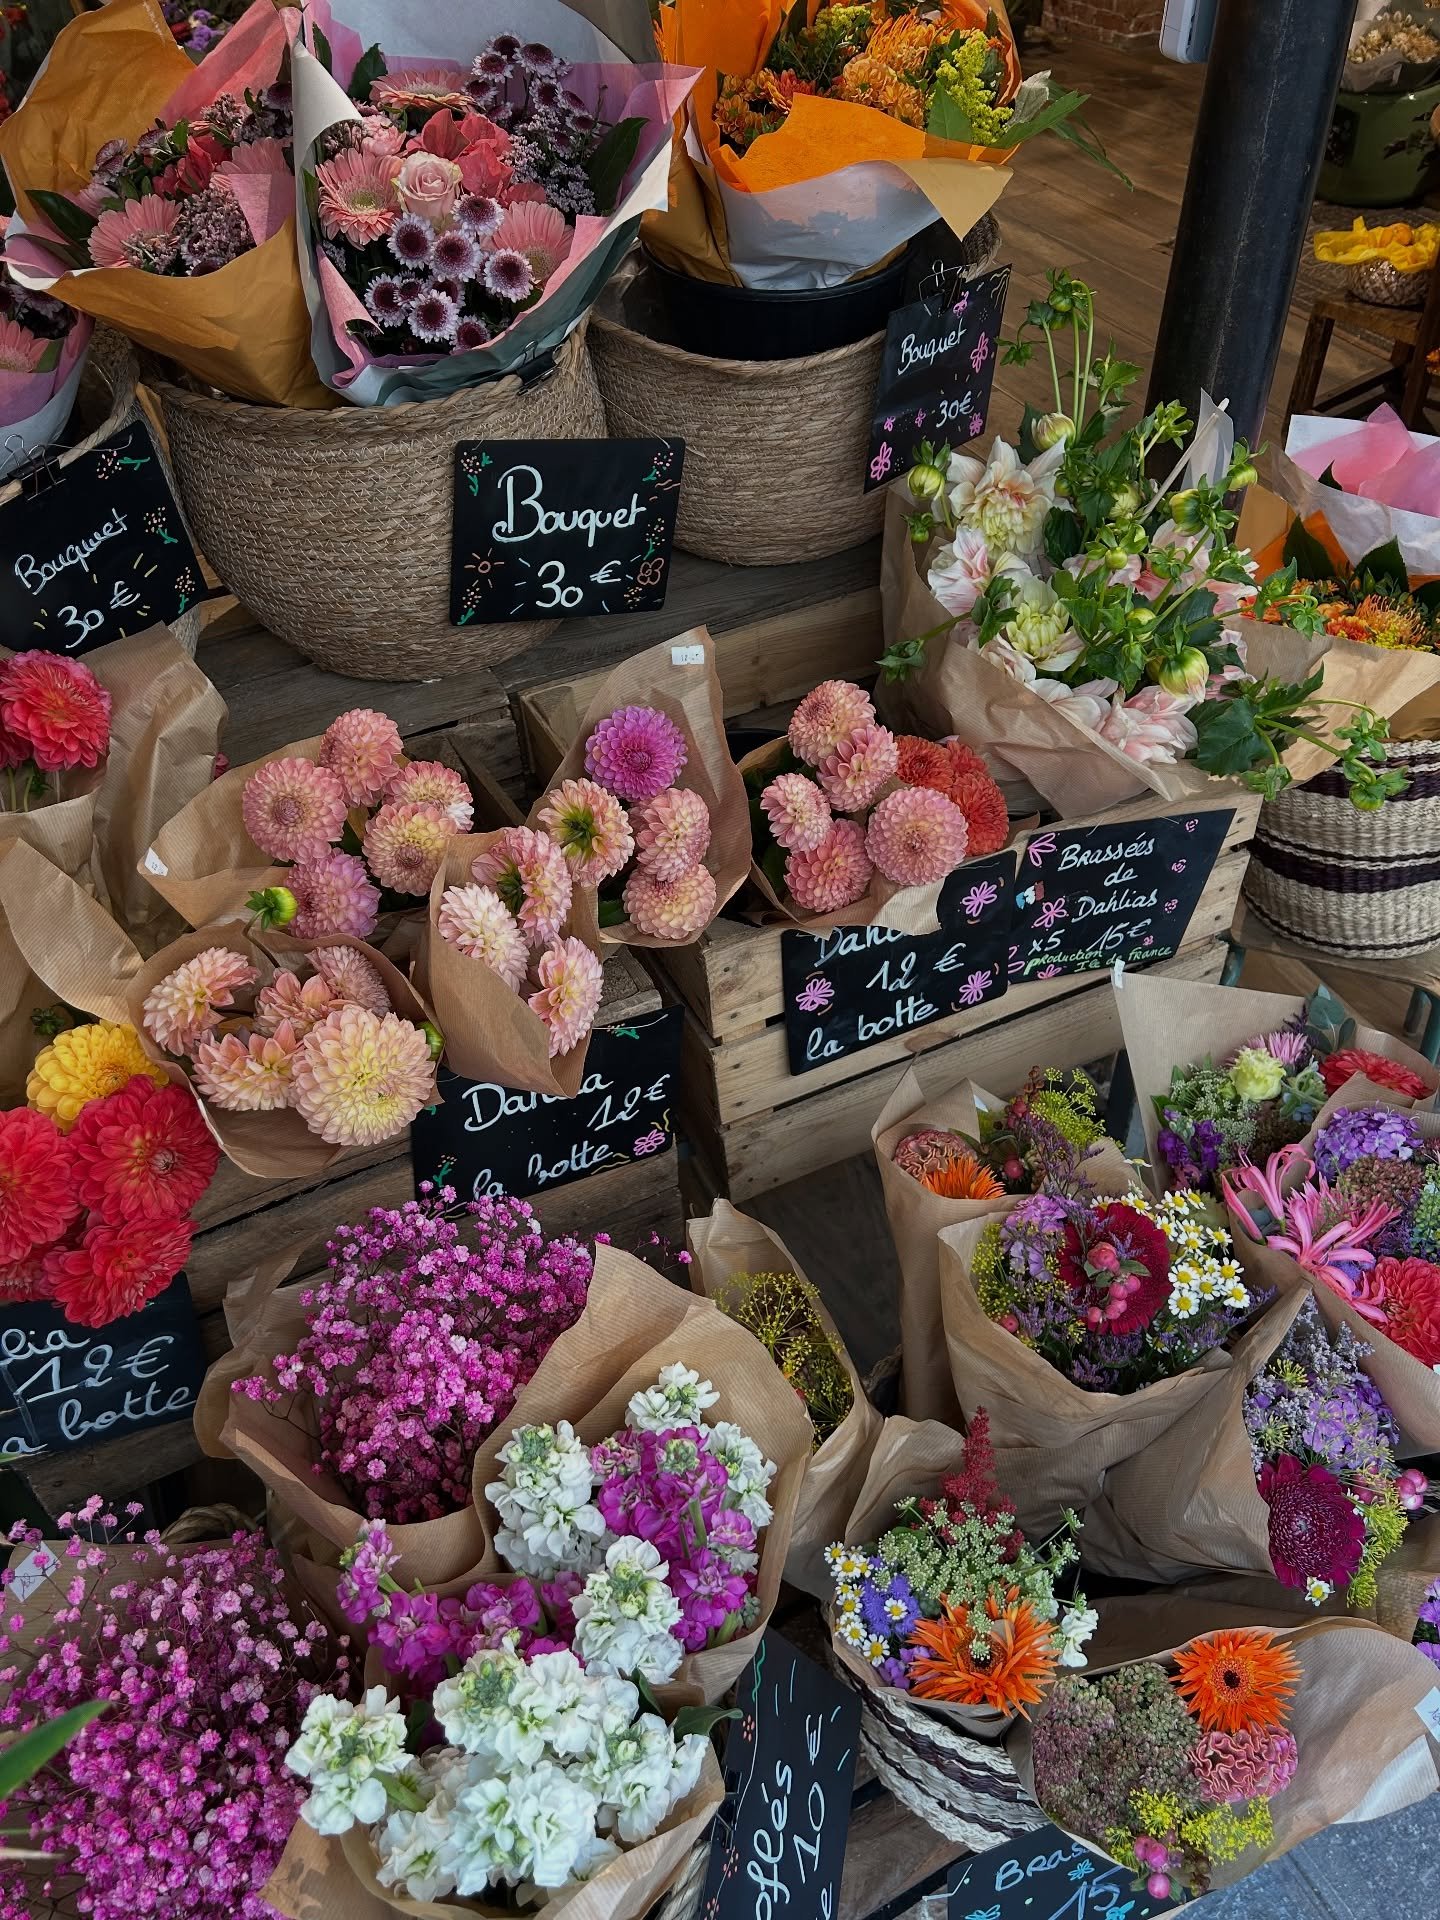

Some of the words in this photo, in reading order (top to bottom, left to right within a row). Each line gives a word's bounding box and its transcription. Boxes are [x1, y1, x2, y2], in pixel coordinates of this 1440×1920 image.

[897, 318, 968, 376] Bouquet
[491, 464, 647, 547] Bouquet
[14, 507, 128, 596] Bouquet
[535, 560, 584, 608] 30
[1057, 831, 1156, 872] Brassées
[1103, 862, 1139, 887] de
[1071, 889, 1158, 924] Dahlias
[866, 951, 917, 992] 12
[806, 1027, 844, 1061] la
[858, 992, 940, 1041] botte
[58, 1380, 197, 1441] botte
